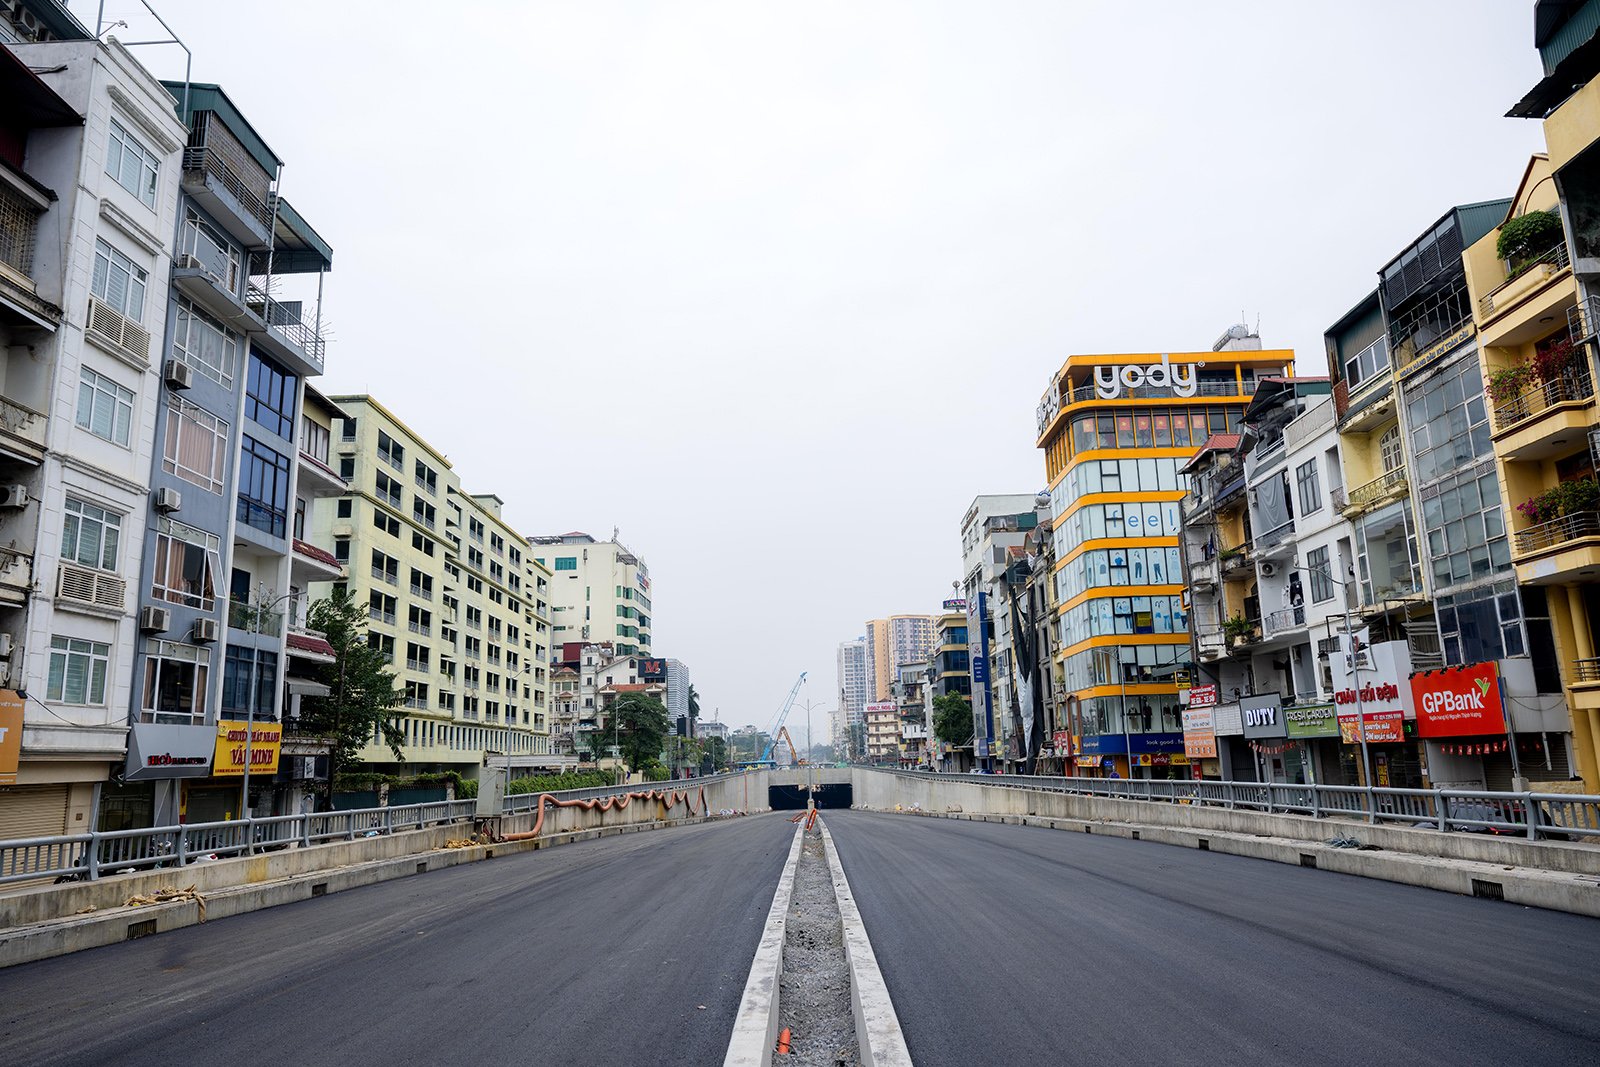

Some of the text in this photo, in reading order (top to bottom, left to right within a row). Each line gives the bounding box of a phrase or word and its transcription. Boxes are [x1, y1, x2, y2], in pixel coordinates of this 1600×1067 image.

[1399, 368, 1413, 378] NGÂN
[1413, 358, 1427, 370] HÀNG
[1436, 344, 1445, 356] KHÍ
[1445, 337, 1458, 350] TOÀN
[1094, 353, 1197, 399] yody
[1112, 509, 1174, 528] feel
[1335, 681, 1399, 705] CHĂN GỐI ĐỆM
[1422, 688, 1485, 714] GPBank
[1245, 707, 1275, 727] DUTY
[1286, 707, 1334, 721] FRESH GARDEN
[249, 748, 274, 766] MINH
